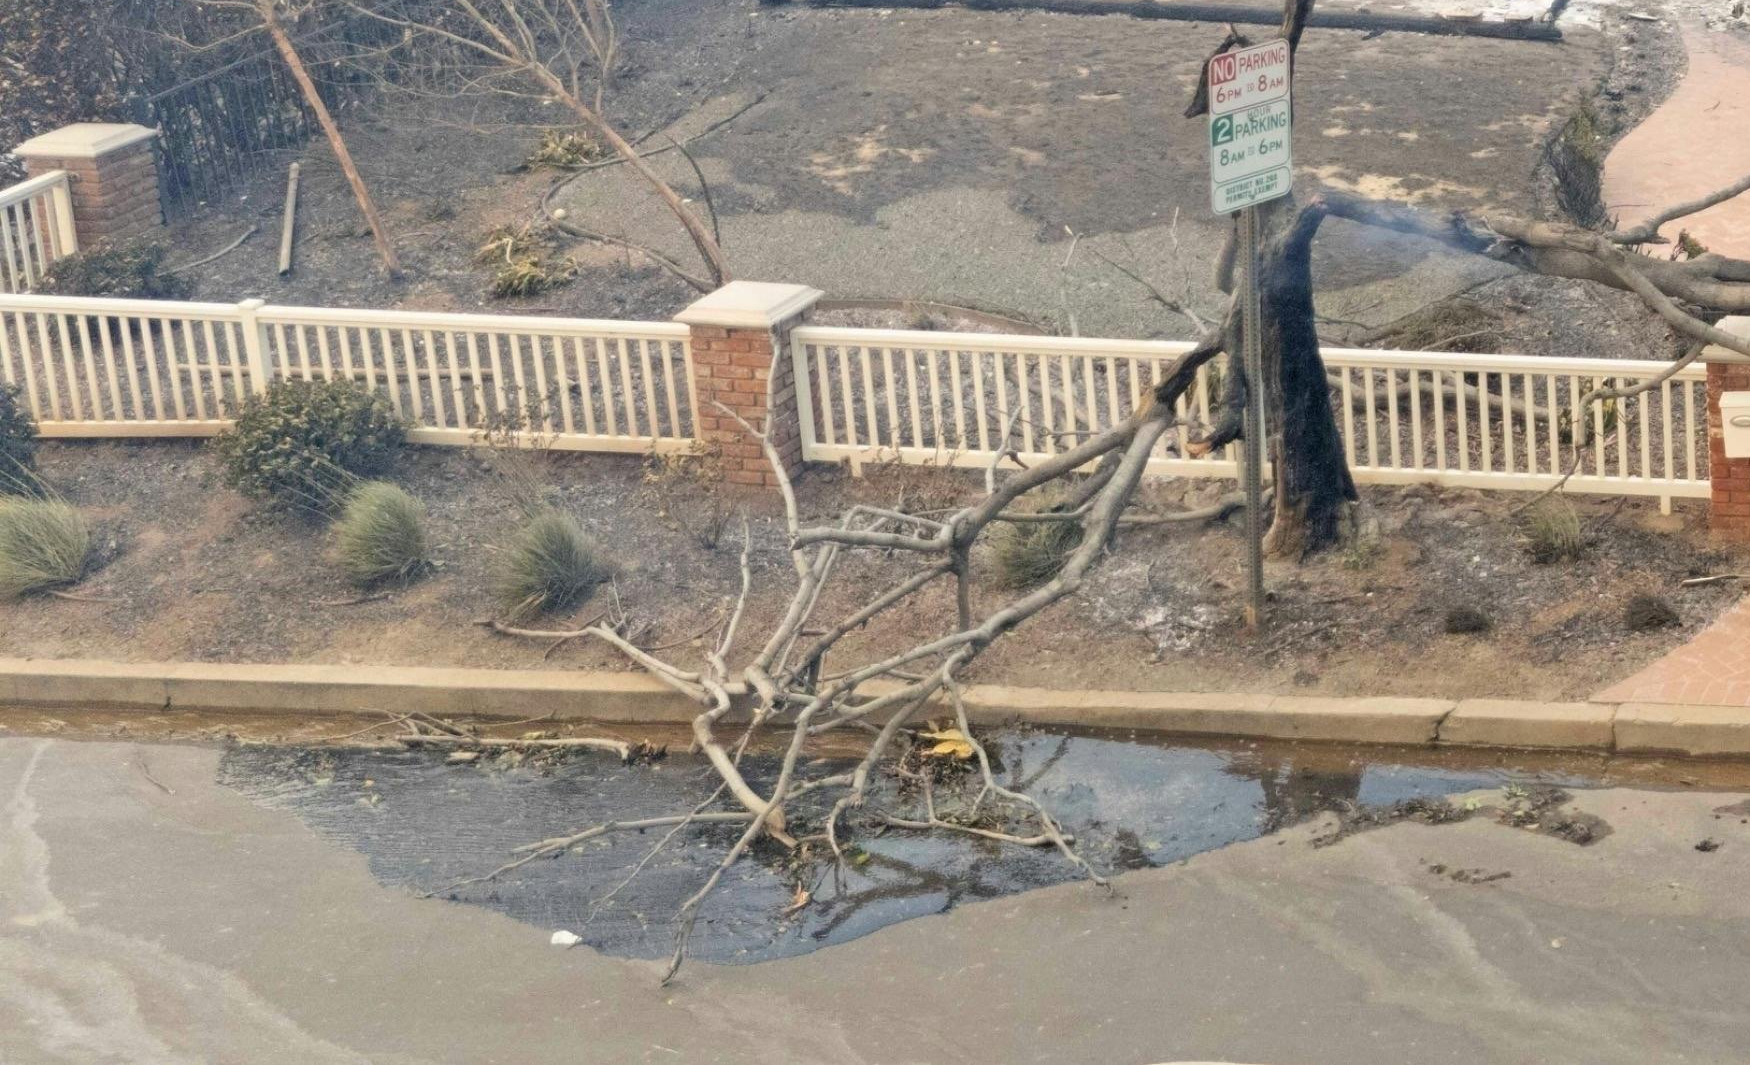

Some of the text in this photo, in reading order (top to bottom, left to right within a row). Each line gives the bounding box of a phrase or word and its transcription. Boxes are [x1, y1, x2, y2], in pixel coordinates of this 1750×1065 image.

[1213, 47, 1285, 83] NO PARKING
[1217, 111, 1287, 142] 2 PARKING
